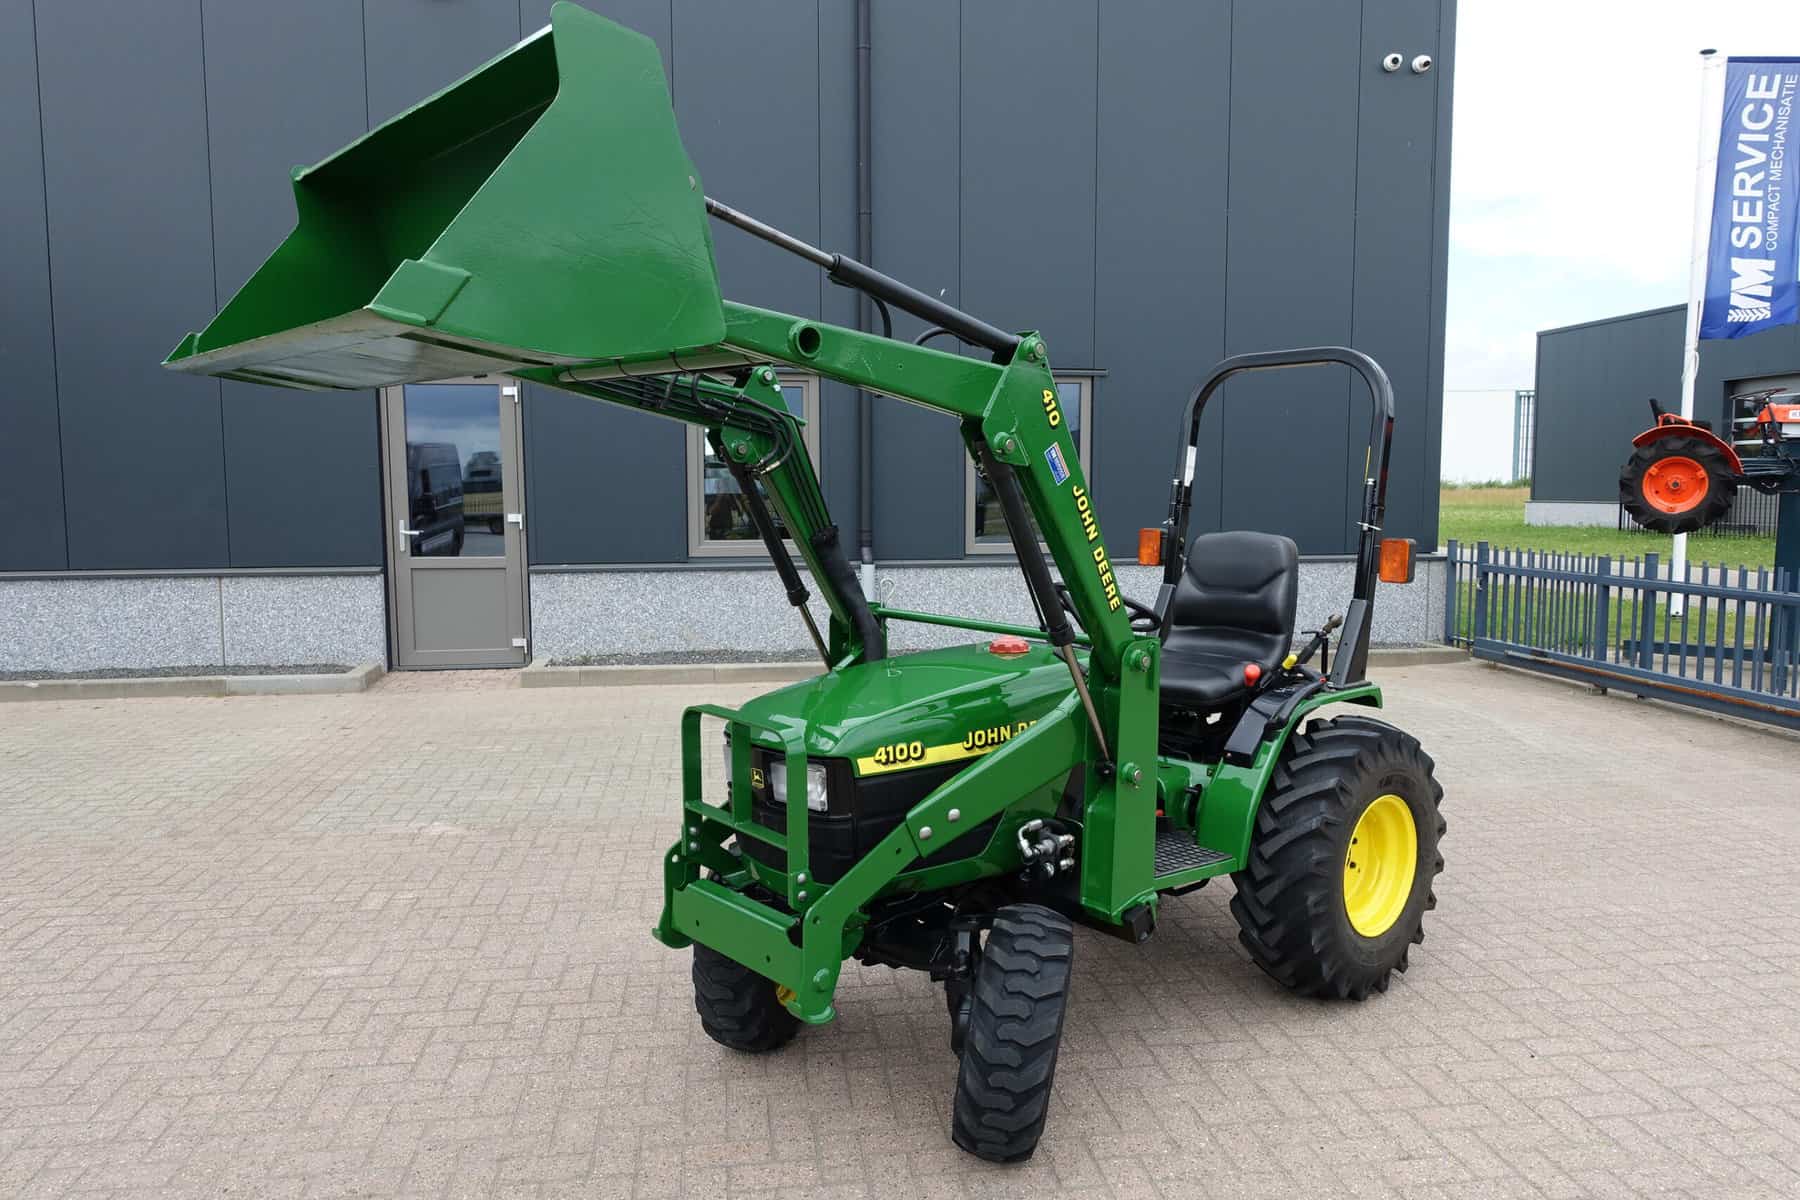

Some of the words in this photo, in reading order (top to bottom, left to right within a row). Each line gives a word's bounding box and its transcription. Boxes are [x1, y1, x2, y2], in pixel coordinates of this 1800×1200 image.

[1769, 74, 1798, 180] MECHANISATIE
[1731, 74, 1781, 249] SERVICE
[1765, 184, 1781, 251] COMPACT
[1042, 389, 1061, 427] 410
[1073, 485, 1099, 541] JOHN
[1092, 546, 1120, 612] DEERE
[874, 741, 924, 764] 4100
[963, 724, 1012, 750] JOHN
